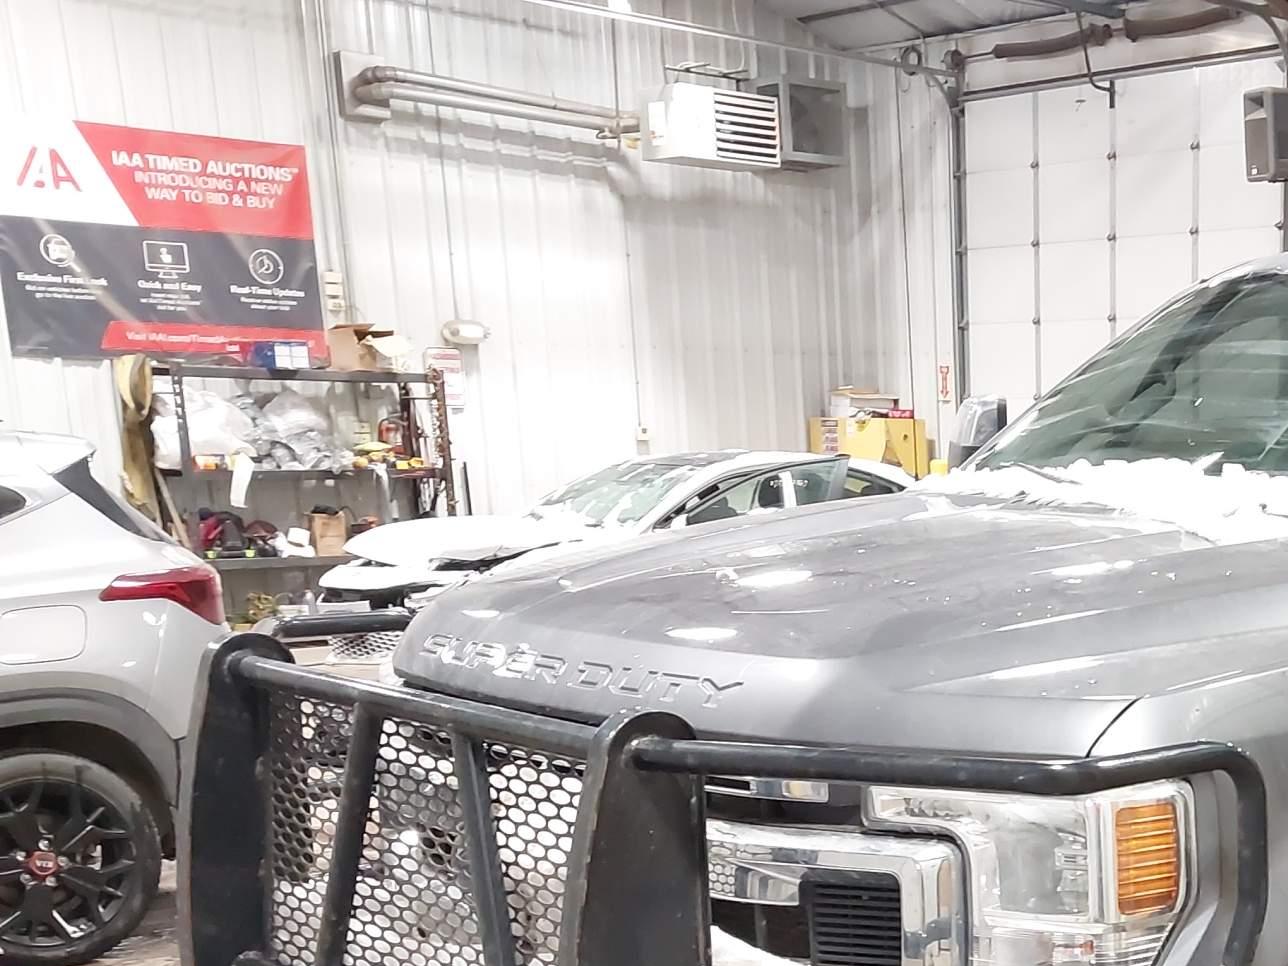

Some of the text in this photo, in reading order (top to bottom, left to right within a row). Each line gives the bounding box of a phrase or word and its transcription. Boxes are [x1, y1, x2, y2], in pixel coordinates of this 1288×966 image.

[111, 150, 145, 168] IAA
[144, 154, 202, 173] TIMED
[134, 171, 284, 196] INTRODUCING A NEW
[144, 186, 277, 209] WAY TO BID & BUY
[418, 634, 744, 709] SUPER DUTY
